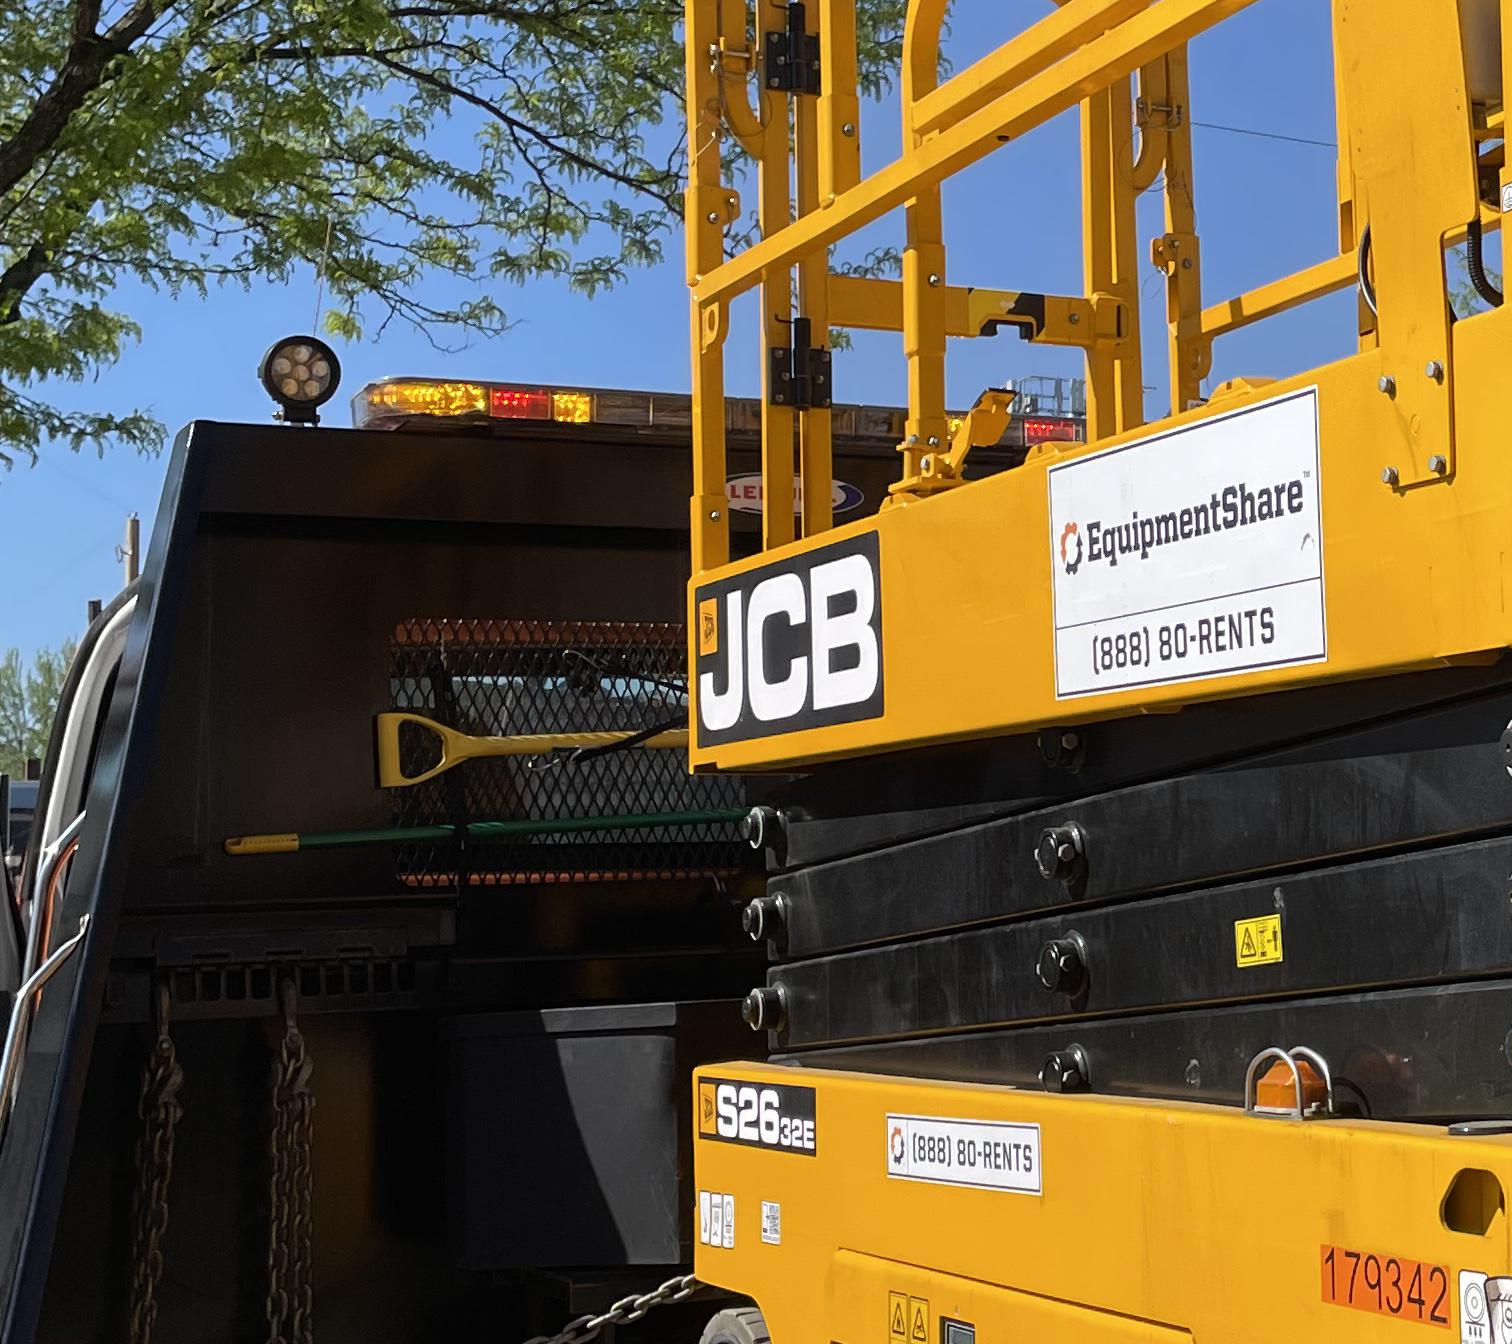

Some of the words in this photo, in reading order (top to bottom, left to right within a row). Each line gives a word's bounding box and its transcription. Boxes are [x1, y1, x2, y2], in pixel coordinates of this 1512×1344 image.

[1087, 479, 1303, 566] EquipmentShare
[699, 554, 878, 731] JCB
[1092, 626, 1150, 675] (888)
[1159, 606, 1275, 661] 80-RENTS
[912, 1132, 951, 1168] (888)
[957, 1139, 1033, 1172] 80-RENTS
[1325, 1247, 1448, 1323] 179342
